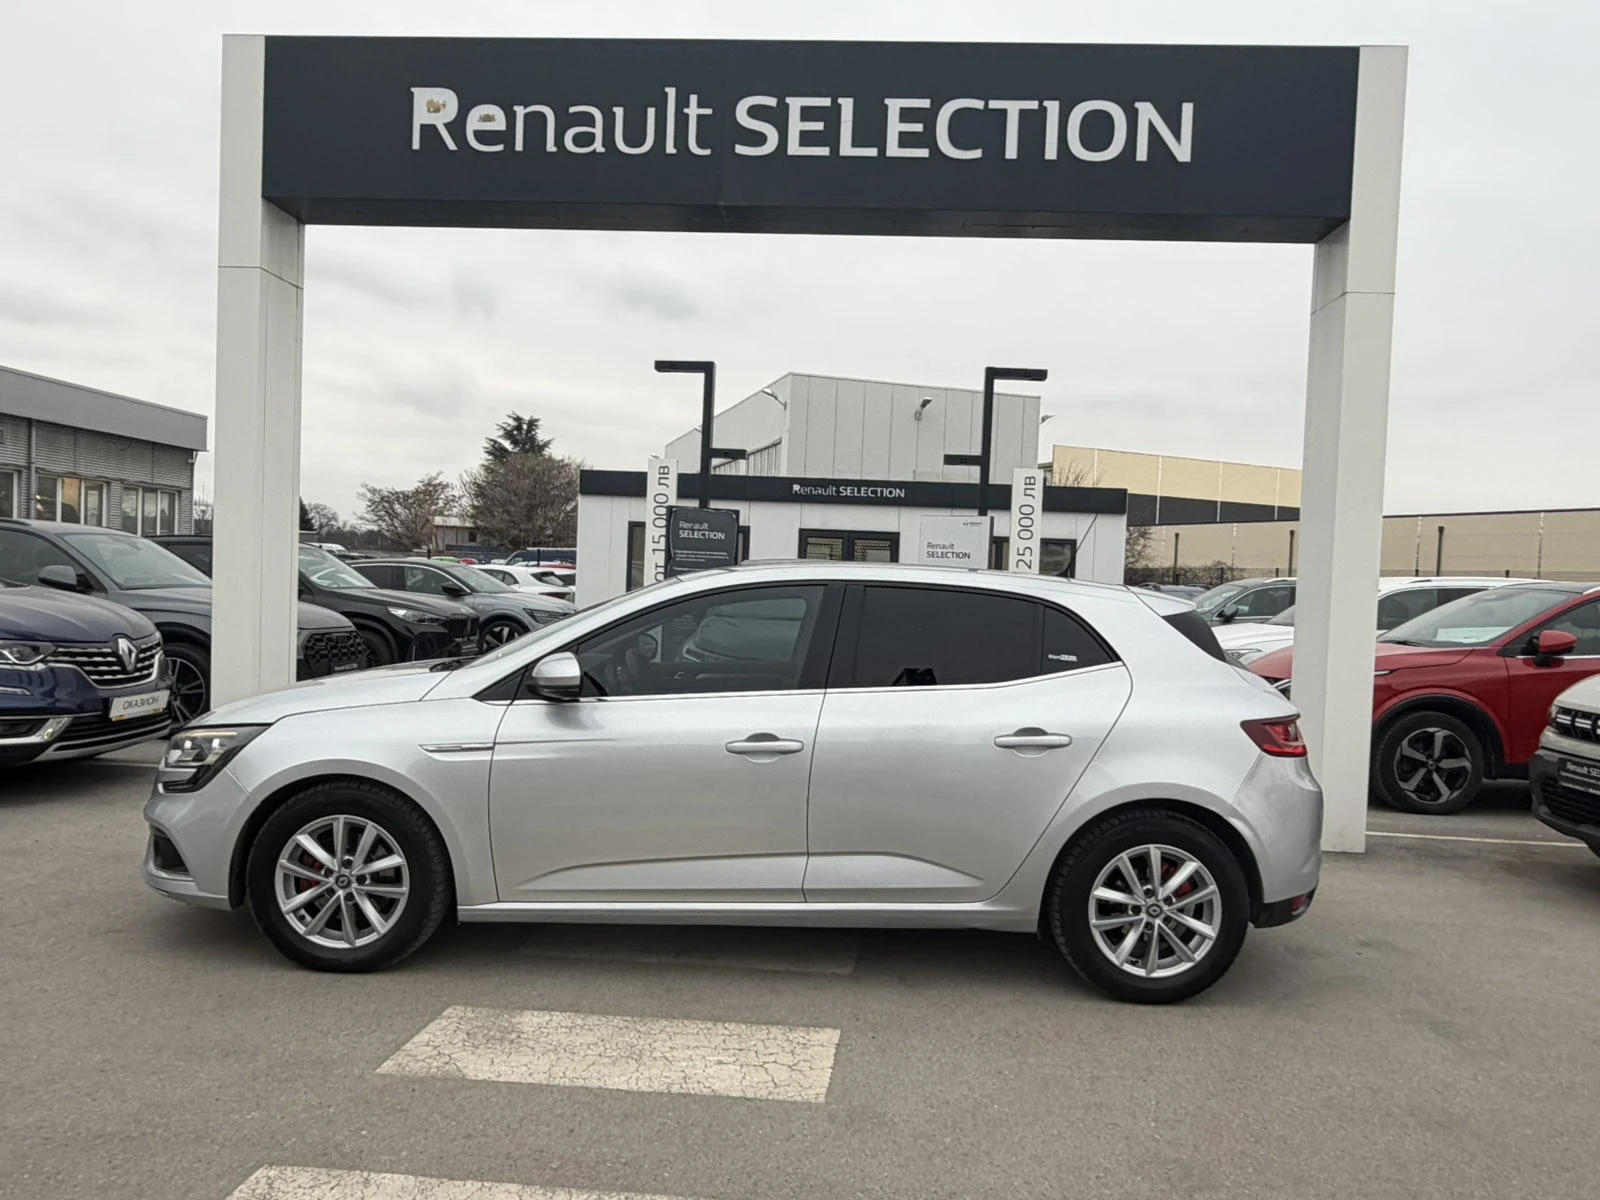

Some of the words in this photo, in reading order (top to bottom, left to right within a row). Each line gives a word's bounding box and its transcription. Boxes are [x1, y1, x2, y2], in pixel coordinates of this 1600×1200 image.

[410, 86, 713, 157] Renault
[734, 95, 1194, 164] SELECTION
[657, 465, 671, 489] лв
[1023, 475, 1037, 500] лв
[792, 484, 838, 497] Renault
[839, 486, 906, 498] SELECTION
[652, 492, 670, 529] 000
[1017, 504, 1035, 541] 000
[678, 529, 726, 540] SELECTION
[679, 520, 709, 530] Renault
[926, 541, 955, 550] Renault
[926, 550, 971, 560] SELECTION
[1015, 546, 1033, 570] 25
